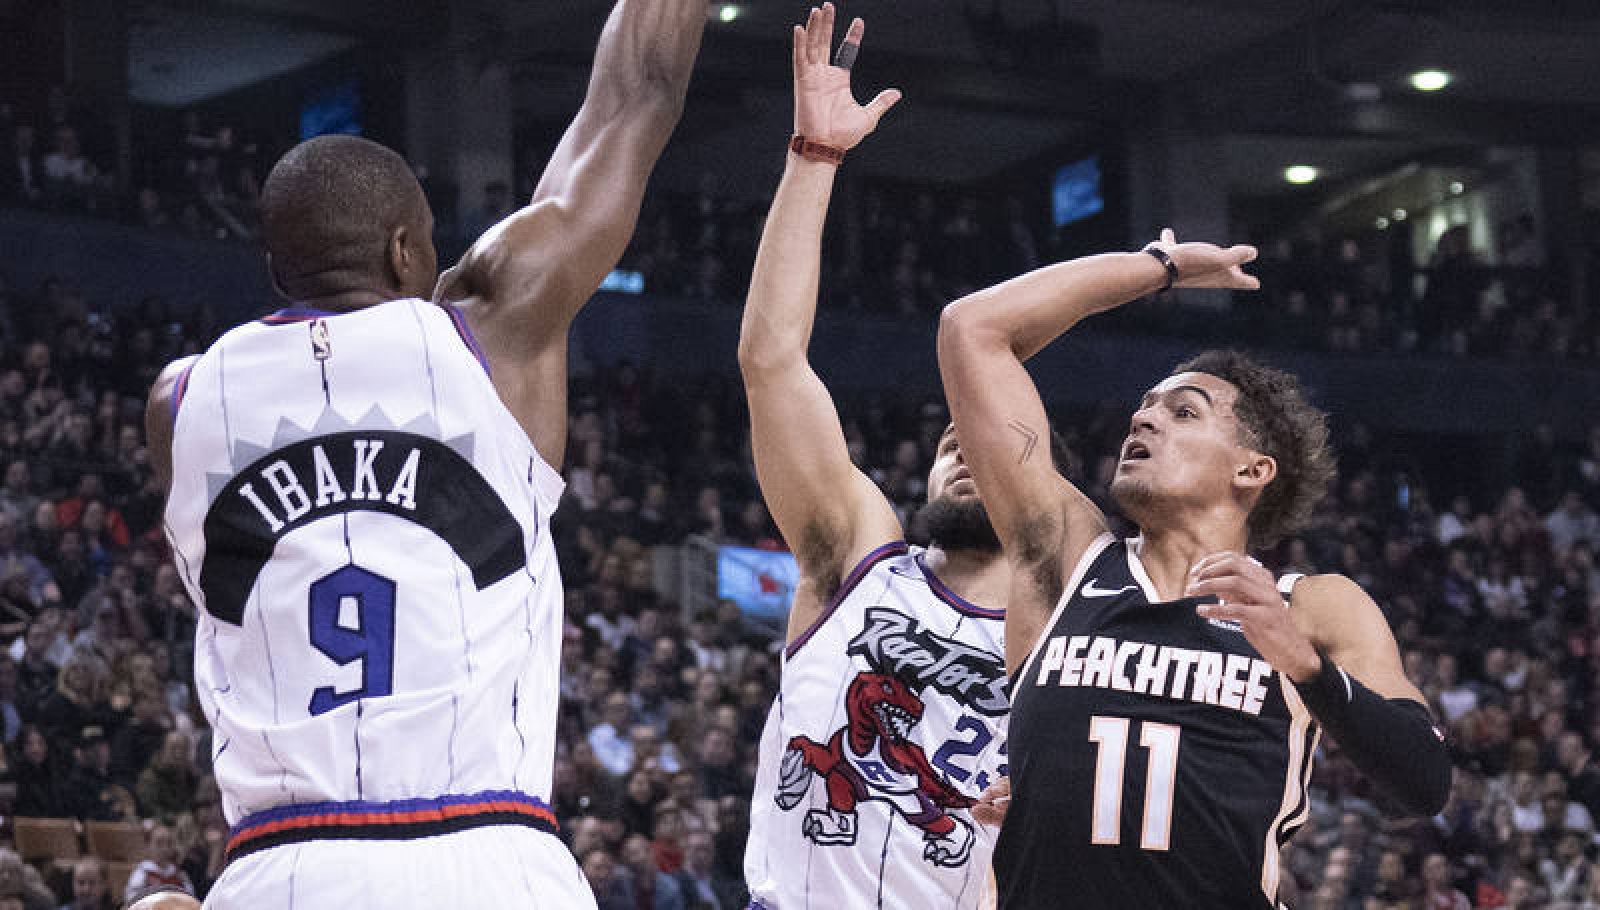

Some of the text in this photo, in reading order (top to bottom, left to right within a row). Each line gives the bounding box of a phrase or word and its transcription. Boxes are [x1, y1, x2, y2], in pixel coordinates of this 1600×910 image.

[238, 440, 421, 533] IBAKA
[308, 564, 397, 716] 9
[1036, 635, 1273, 716] PEACHTREE
[1088, 715, 1182, 851] 11
